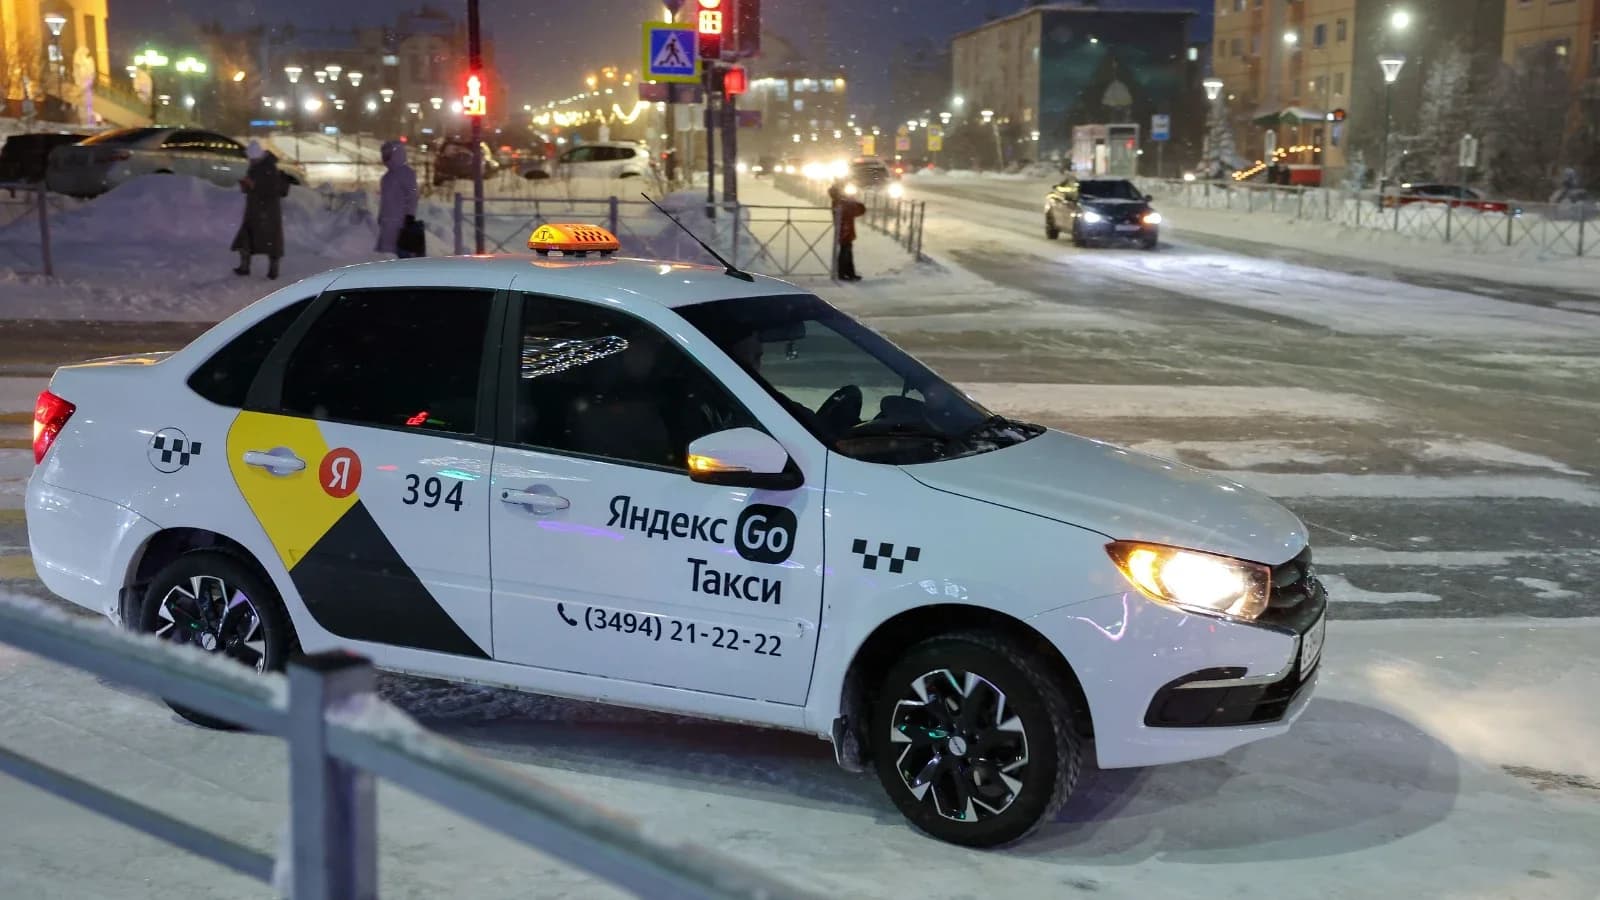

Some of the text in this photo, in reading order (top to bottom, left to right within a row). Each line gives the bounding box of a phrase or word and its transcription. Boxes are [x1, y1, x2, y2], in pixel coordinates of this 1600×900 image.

[328, 456, 351, 490] Я
[402, 473, 464, 512] 394
[607, 495, 788, 553] Яндекс Go
[688, 557, 782, 605] Такси
[585, 606, 782, 657] (3494) 21-22-22
